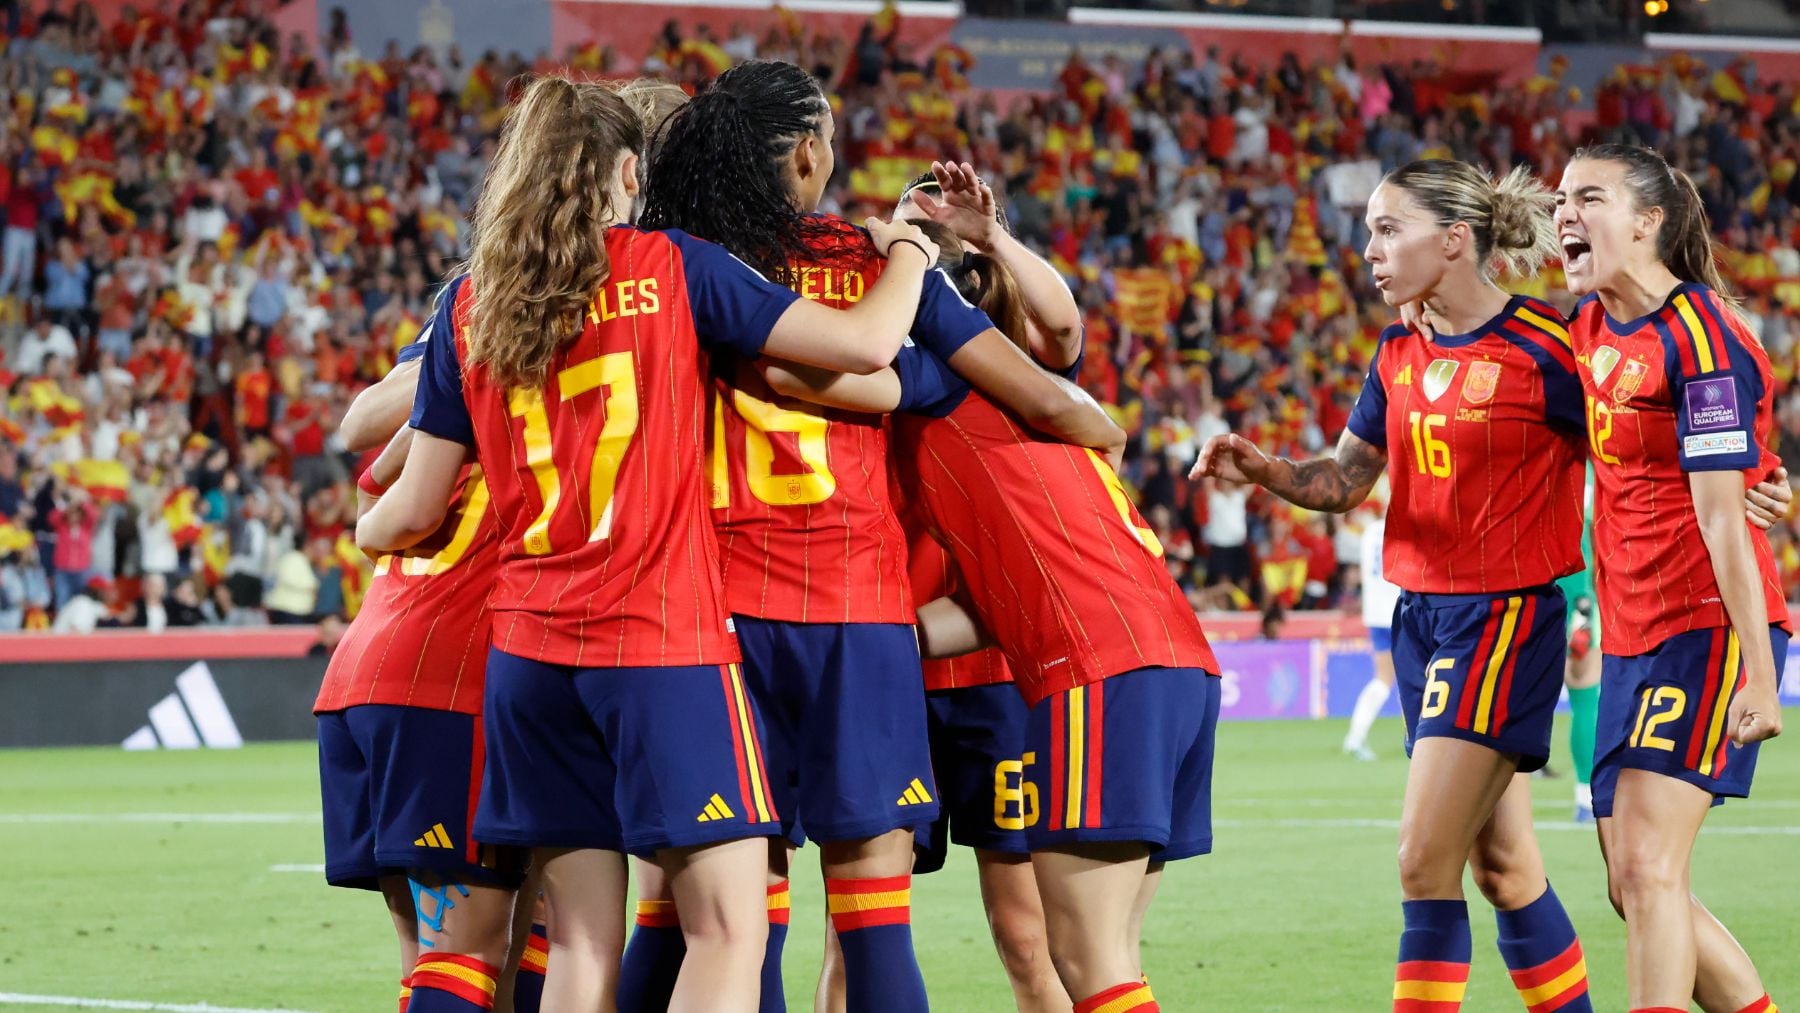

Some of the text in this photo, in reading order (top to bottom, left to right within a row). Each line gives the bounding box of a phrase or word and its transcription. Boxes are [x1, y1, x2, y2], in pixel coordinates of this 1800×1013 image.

[1409, 411, 1452, 478] 16
[1587, 395, 1622, 465] 12
[1686, 437, 1745, 449] FOUNDATION
[1694, 409, 1733, 419] EUROPEAN
[1694, 415, 1734, 425] QUALIFIERS
[508, 350, 639, 555] 17
[1629, 686, 1687, 751] 12
